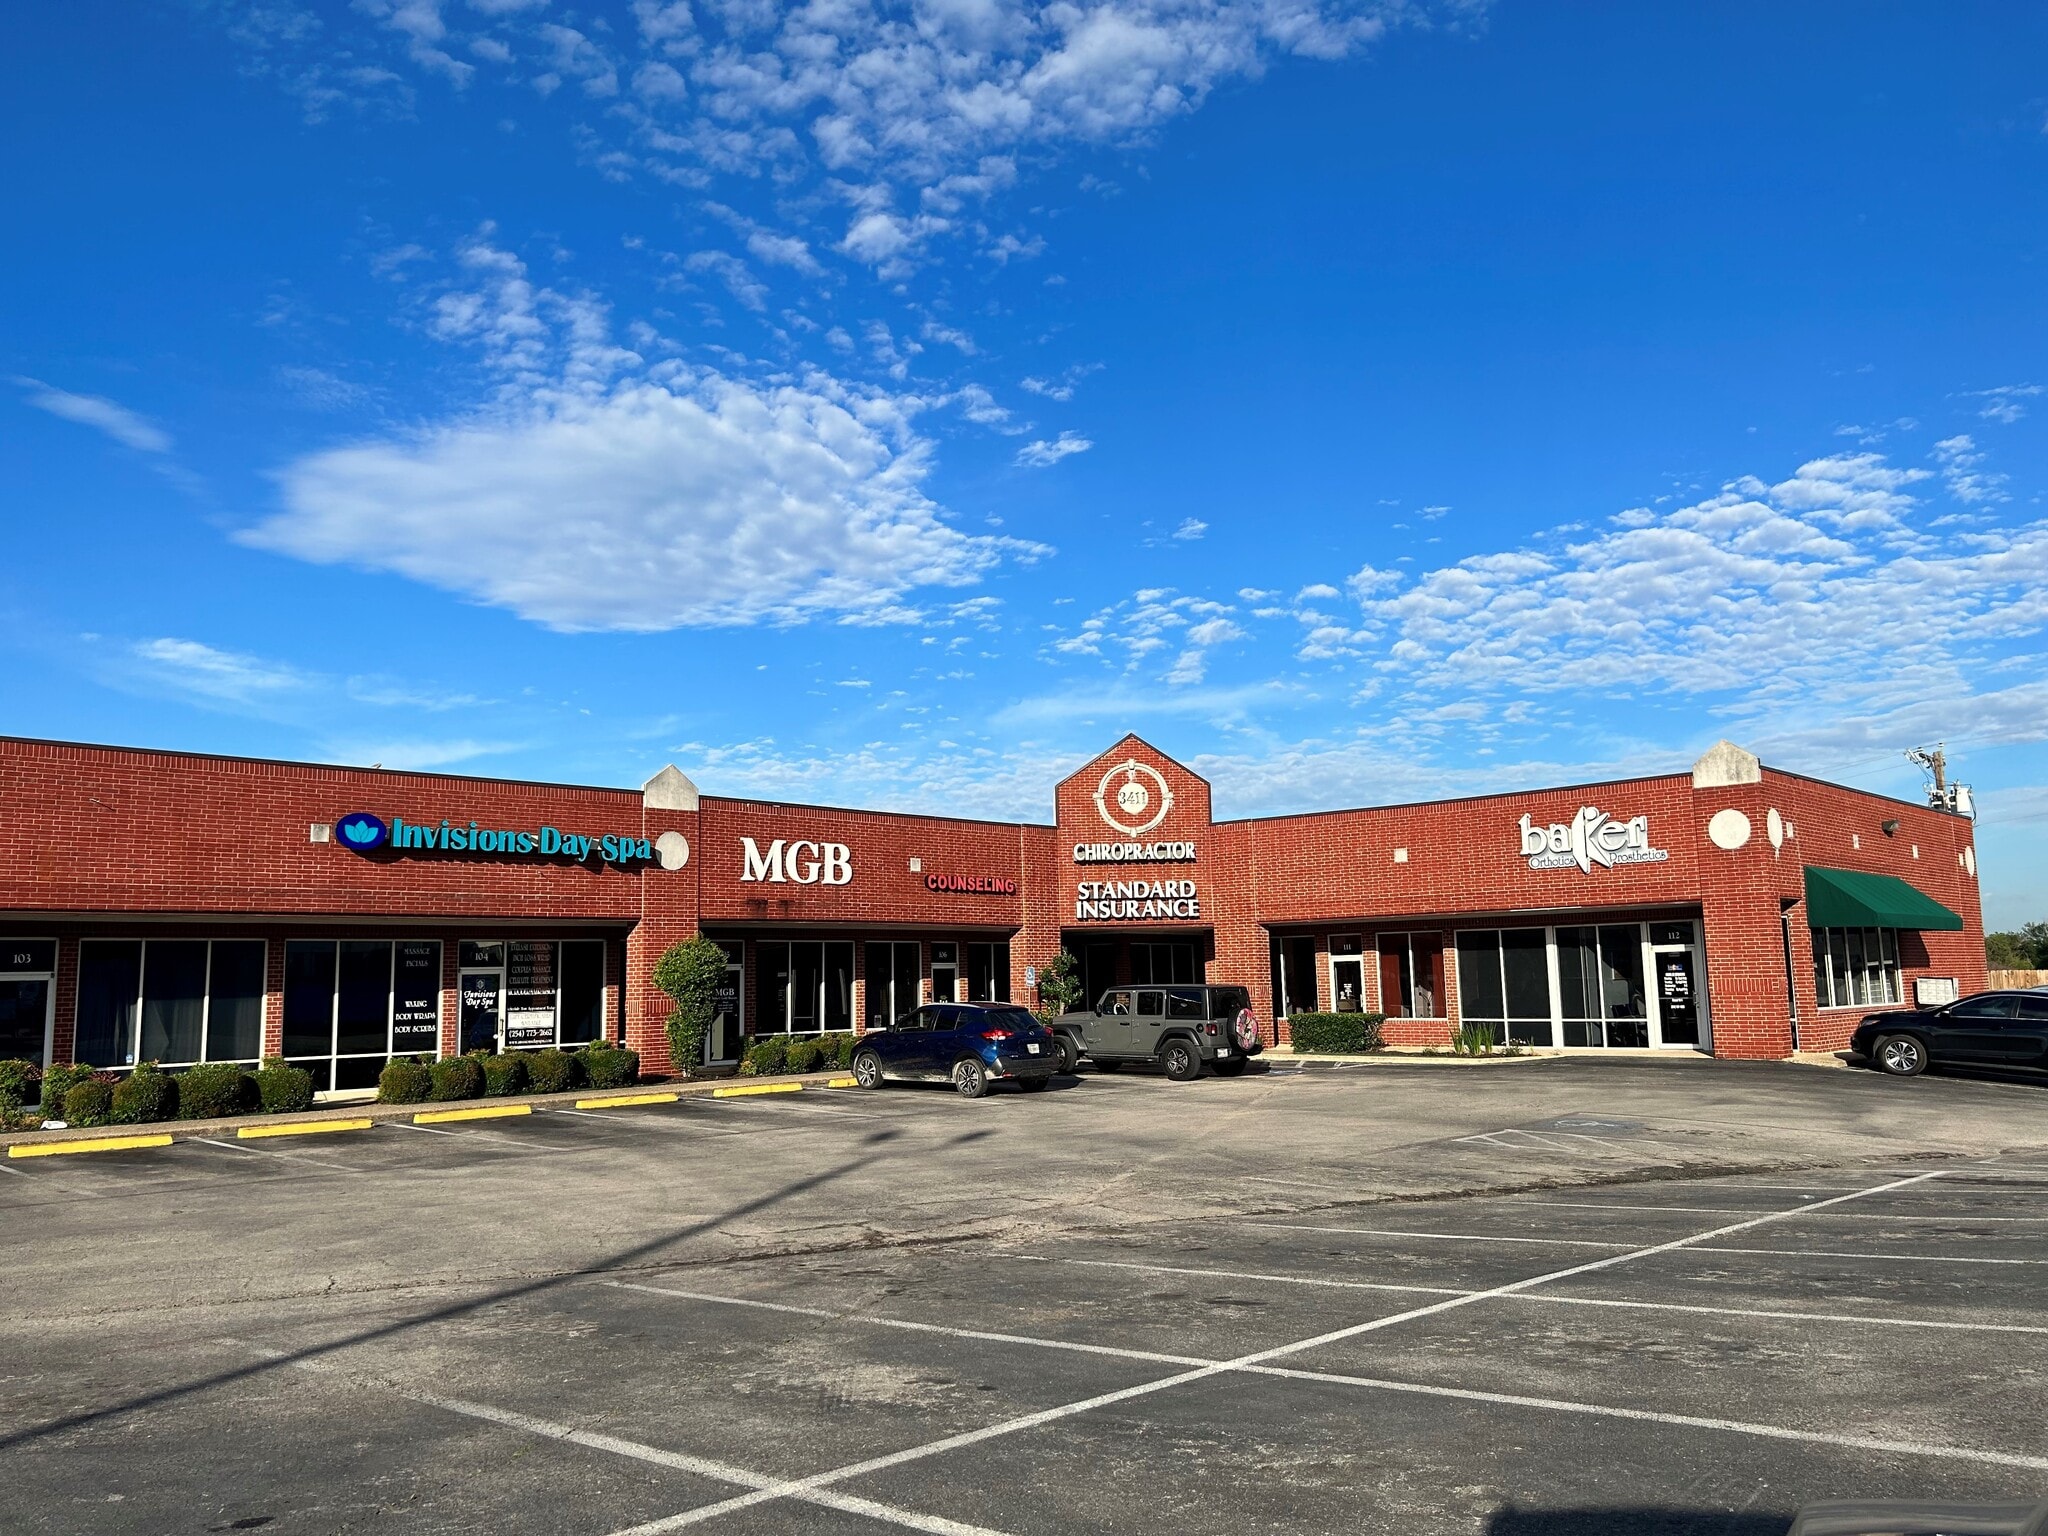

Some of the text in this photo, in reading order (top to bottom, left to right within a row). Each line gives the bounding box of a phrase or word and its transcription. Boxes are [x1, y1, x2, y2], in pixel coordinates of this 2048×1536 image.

[1119, 791, 1147, 805] 3411
[391, 818, 653, 863] Invisions Day Spa
[1518, 806, 1648, 874] baker
[1074, 842, 1196, 861] CHIROPRACTOR
[740, 836, 853, 885] MGB
[1530, 850, 1667, 868] Orthotics Prosthetics
[926, 874, 1015, 893] COUNSELING
[1077, 880, 1196, 900] STANDARD
[1075, 899, 1200, 919] INSURANCE
[1668, 931, 1680, 940] 112
[404, 947, 431, 955] MASSAGE
[475, 952, 489, 961] 104
[13, 953, 32, 964] 103
[715, 988, 735, 996] MGB
[465, 998, 481, 1009] Day
[481, 998, 494, 1009] Spa
[413, 1012, 436, 1020] WRAPS
[394, 1025, 436, 1034] BODY SCRUBS
